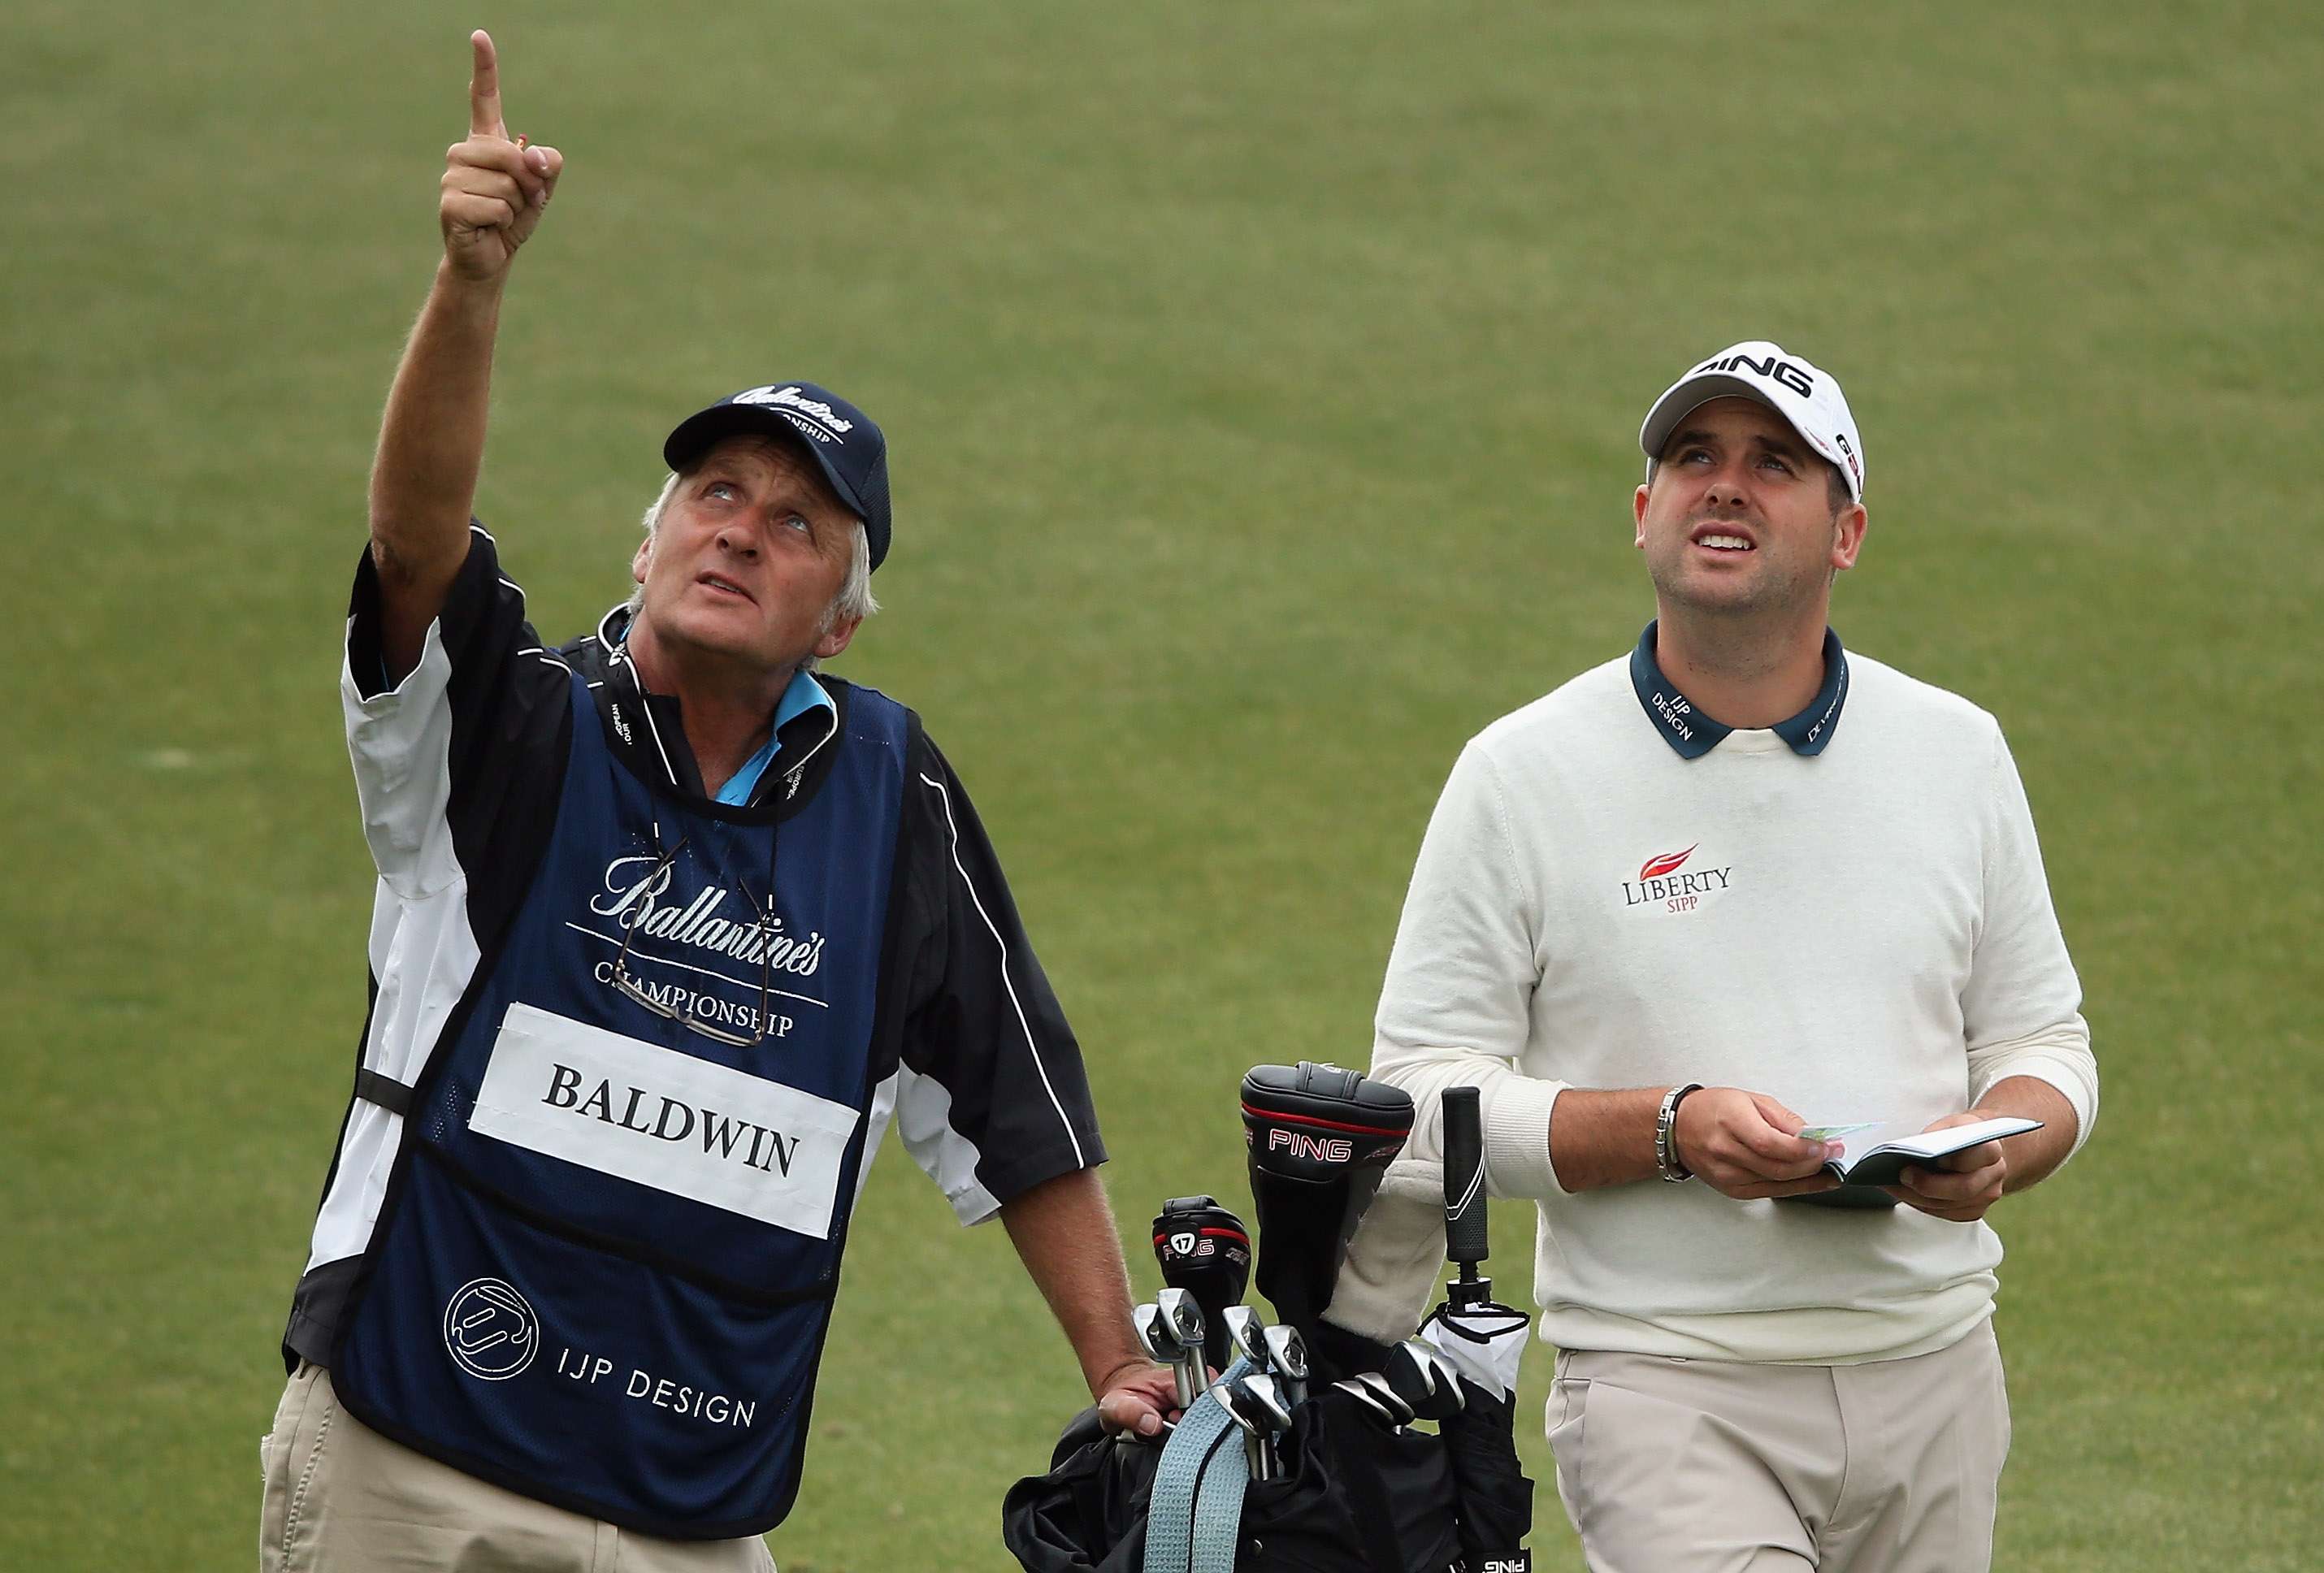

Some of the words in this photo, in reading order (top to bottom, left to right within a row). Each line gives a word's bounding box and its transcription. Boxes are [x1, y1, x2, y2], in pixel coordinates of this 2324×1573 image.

[1651, 691, 1693, 742] DESIGN
[1670, 695, 1691, 715] IJP
[1622, 867, 1732, 906] LIBERTY
[1667, 895, 1698, 913] SIPP
[590, 856, 826, 977] Ballantine's
[541, 1064, 800, 1178] BALDWIN
[1268, 1128, 1353, 1163] PING
[1175, 1236, 1191, 1250] 17
[557, 1348, 614, 1384] IJP
[626, 1368, 757, 1428] DESIGN
